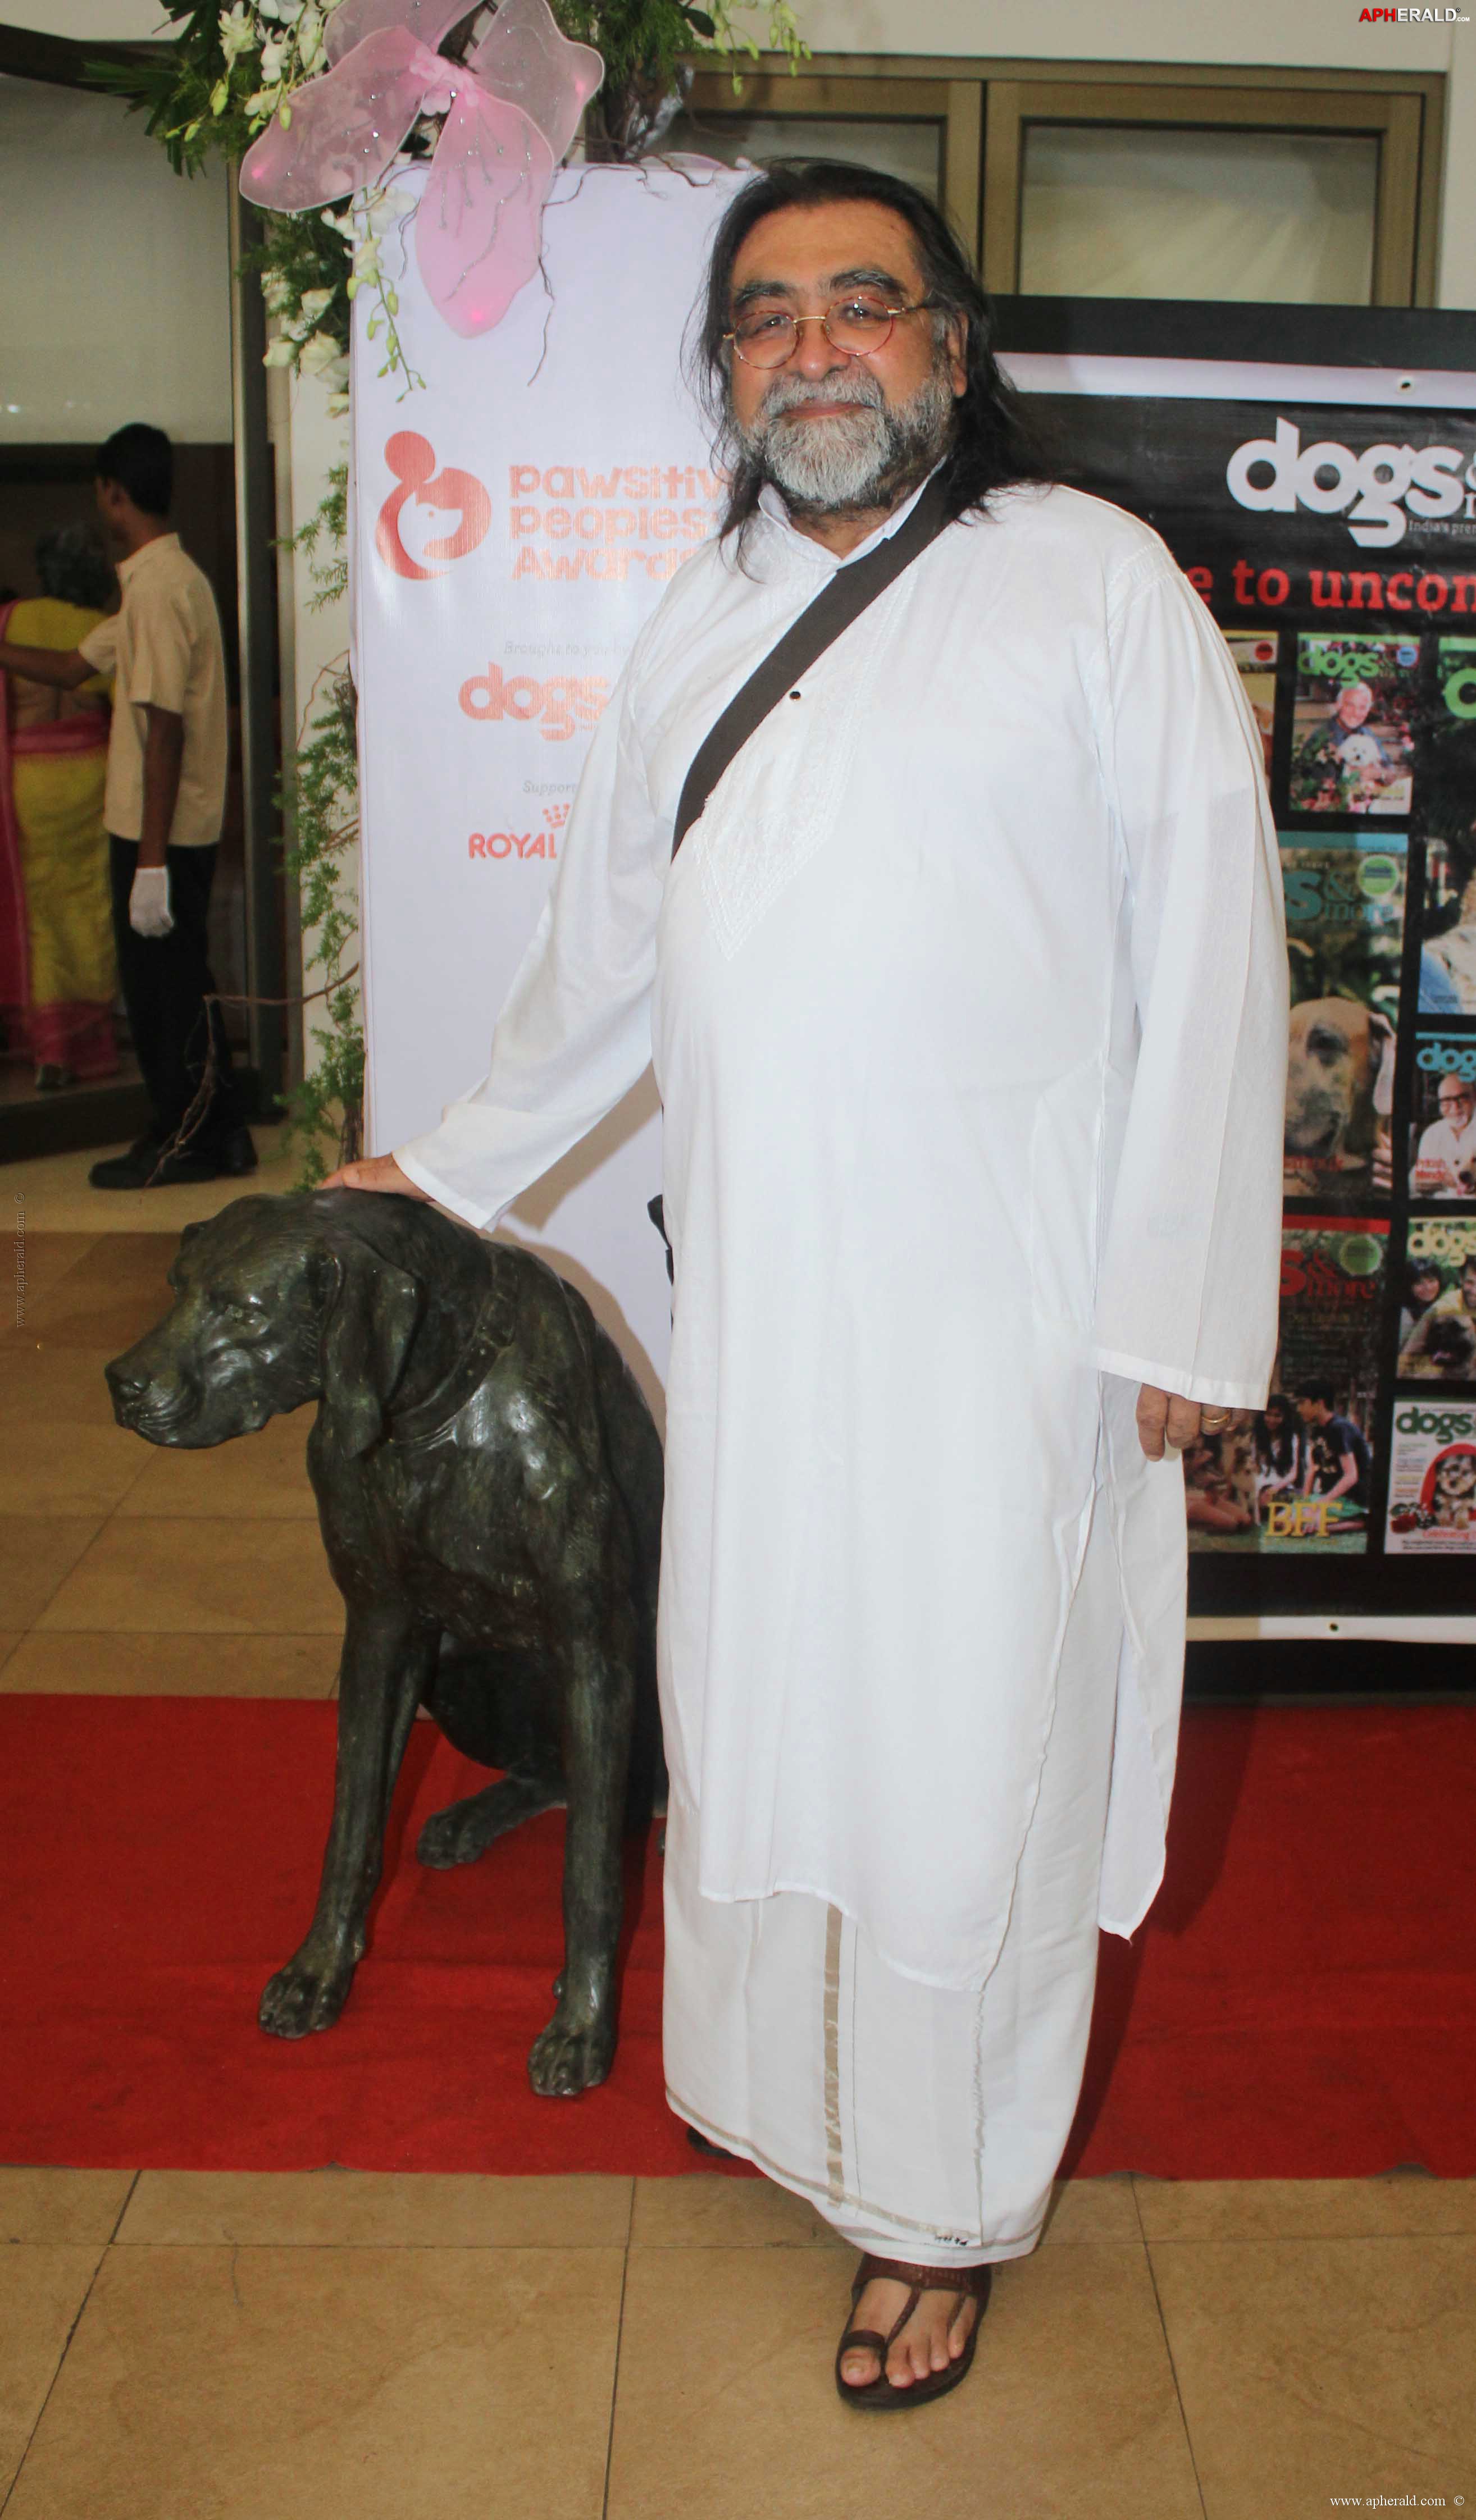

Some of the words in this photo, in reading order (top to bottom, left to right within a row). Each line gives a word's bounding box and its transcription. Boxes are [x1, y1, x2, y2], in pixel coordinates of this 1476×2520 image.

[508, 464, 733, 499] pawsitiv
[1227, 417, 1464, 547] dogs
[1232, 560, 1290, 605] to
[1298, 645, 1379, 688] dogs
[458, 661, 611, 741] dogs
[522, 780, 576, 796] Support
[468, 832, 557, 860] ROYAL
[1396, 1407, 1473, 1444] dogs
[1264, 1501, 1343, 1537] BFF
